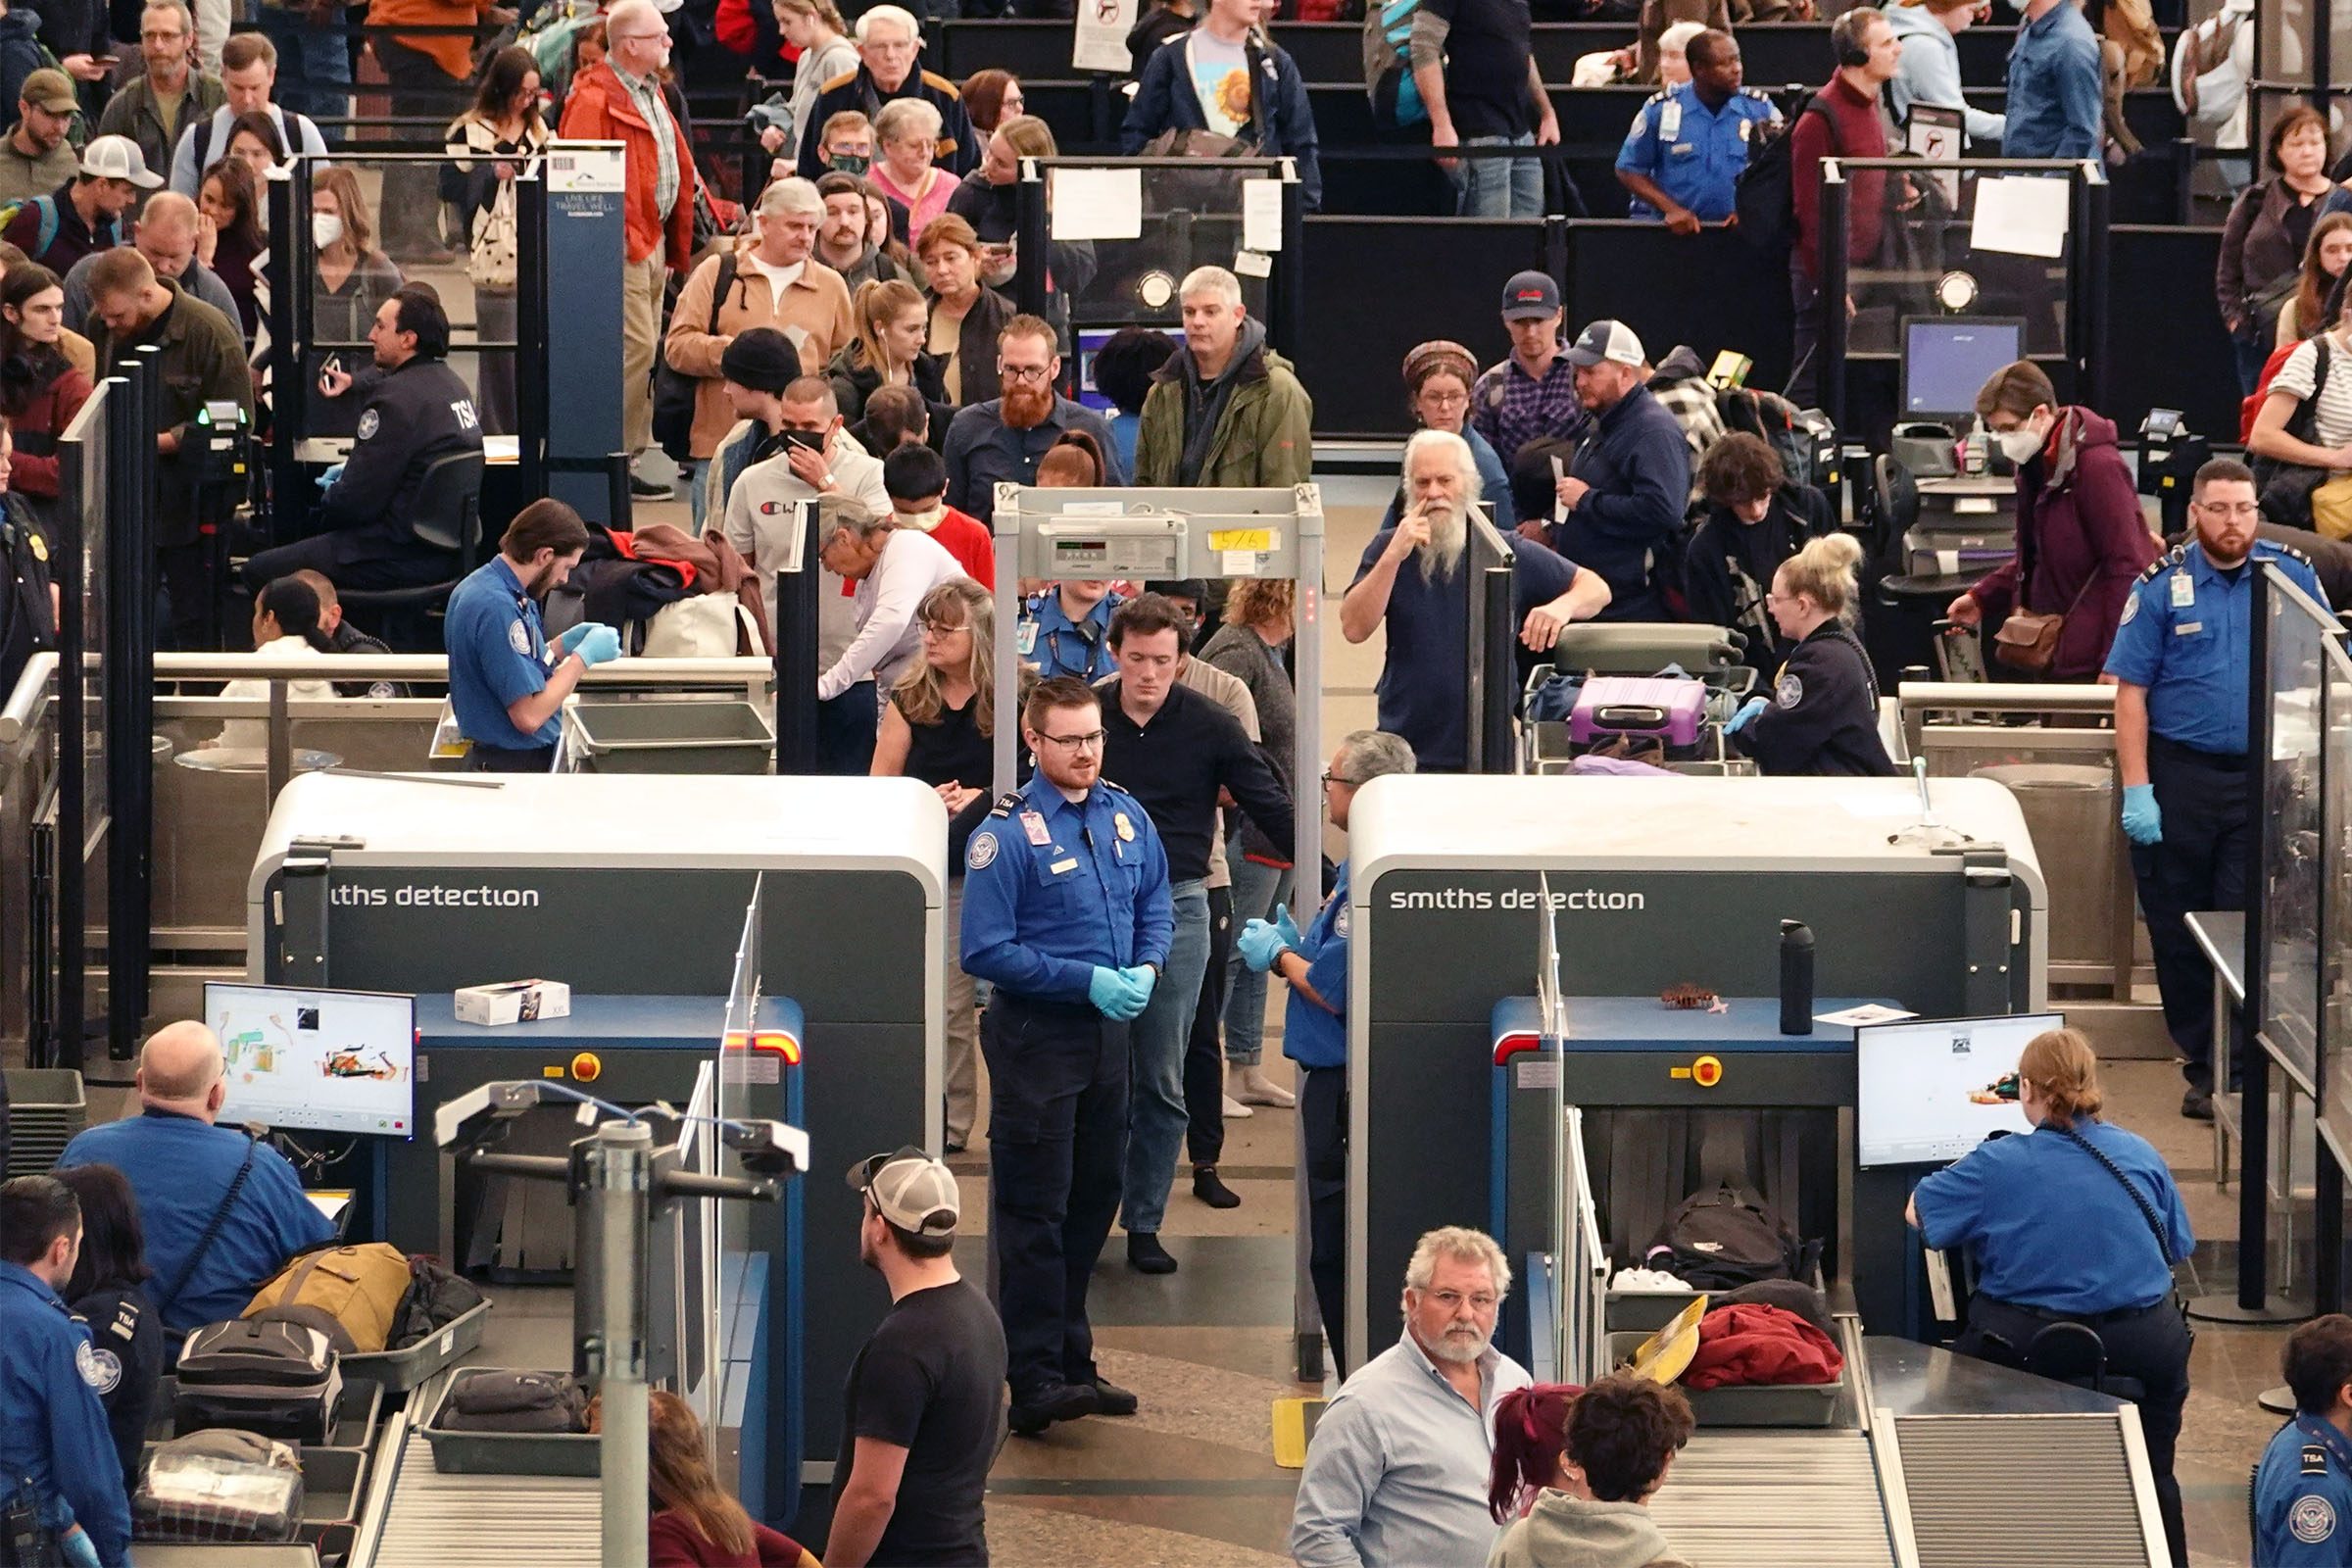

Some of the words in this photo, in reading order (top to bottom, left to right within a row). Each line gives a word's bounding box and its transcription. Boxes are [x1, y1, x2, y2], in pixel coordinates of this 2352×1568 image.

[451, 399, 478, 429] TSA
[999, 797, 1014, 808] TSA
[330, 885, 388, 906] iths
[394, 885, 539, 906] detection
[1390, 888, 1493, 909] smiths
[1500, 888, 1644, 909] detection
[119, 1311, 135, 1328] TSA
